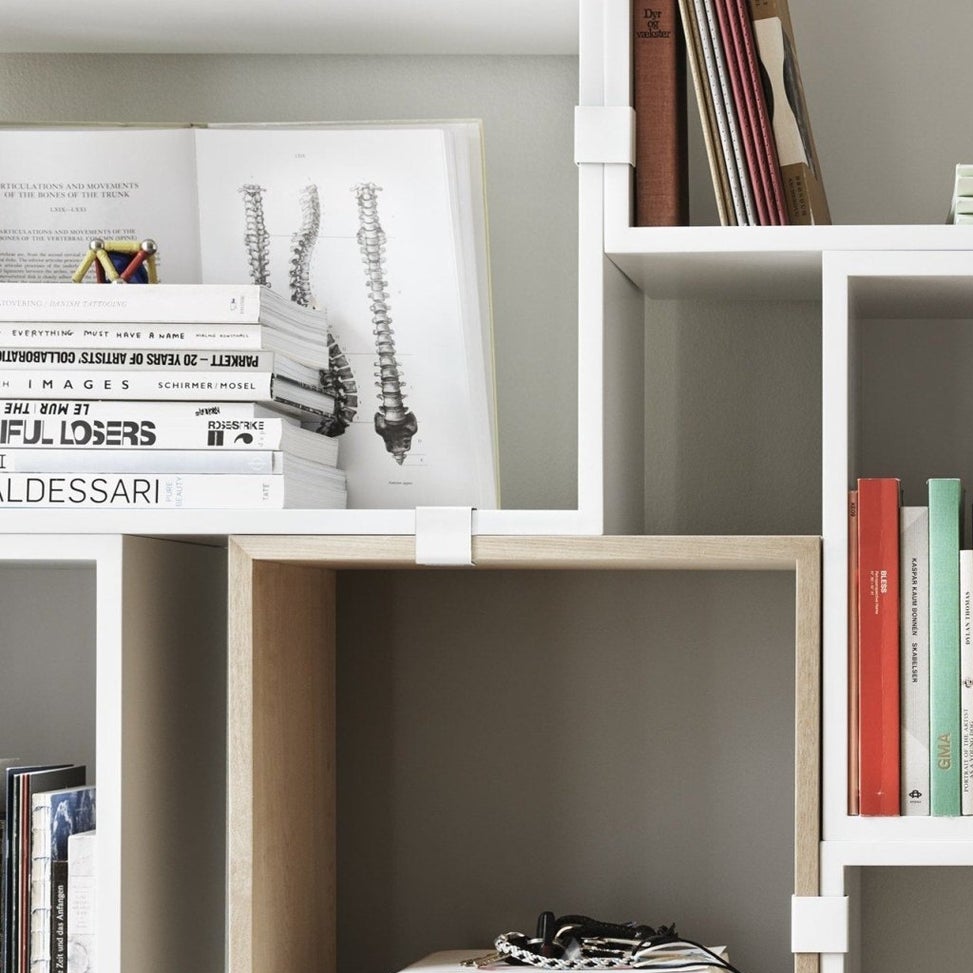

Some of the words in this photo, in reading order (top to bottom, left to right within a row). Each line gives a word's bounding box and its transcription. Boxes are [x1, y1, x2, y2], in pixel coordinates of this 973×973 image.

[645, 8, 662, 20] Dyr
[647, 20, 660, 30] og
[12, 328, 75, 337] EVERYTHING
[84, 329, 110, 338] MUST
[130, 353, 144, 365] OF
[146, 354, 181, 366] YEARS
[183, 354, 198, 366] 20
[210, 354, 259, 368] PARKETT
[28, 379, 130, 390] IMAGES
[158, 382, 256, 390] SCHIRMER/MOSEL
[4, 402, 30, 414] THE
[40, 403, 69, 414] MUR
[74, 404, 89, 414] LE
[60, 420, 157, 446] LOSERS
[938, 732, 951, 770] GMA
